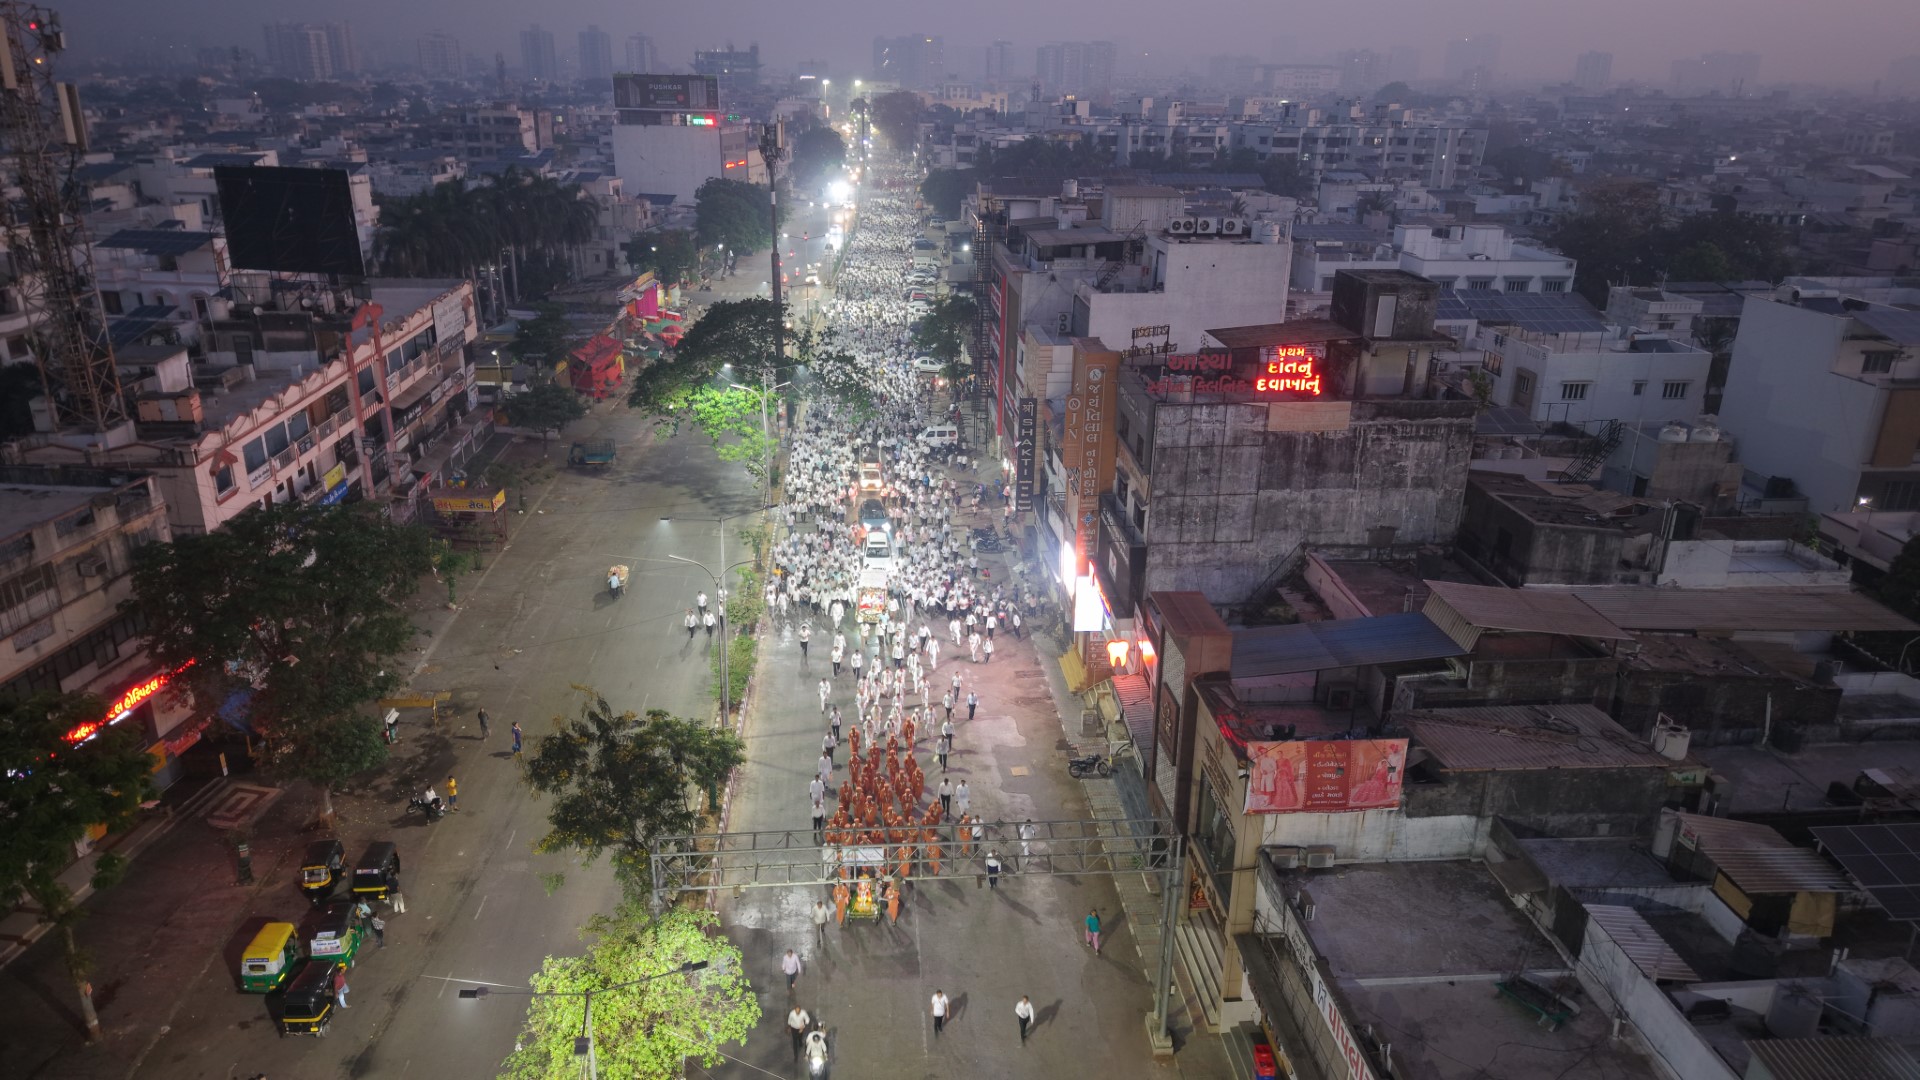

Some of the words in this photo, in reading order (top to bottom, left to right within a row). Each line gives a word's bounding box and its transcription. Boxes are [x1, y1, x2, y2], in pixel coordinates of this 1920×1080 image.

[1278, 347, 1305, 357] પ્રથમ
[1167, 353, 1232, 371] આસ્થા
[1268, 357, 1313, 378] દાંતનું
[1022, 401, 1035, 417] श्री
[1021, 418, 1034, 476] SHAKTI
